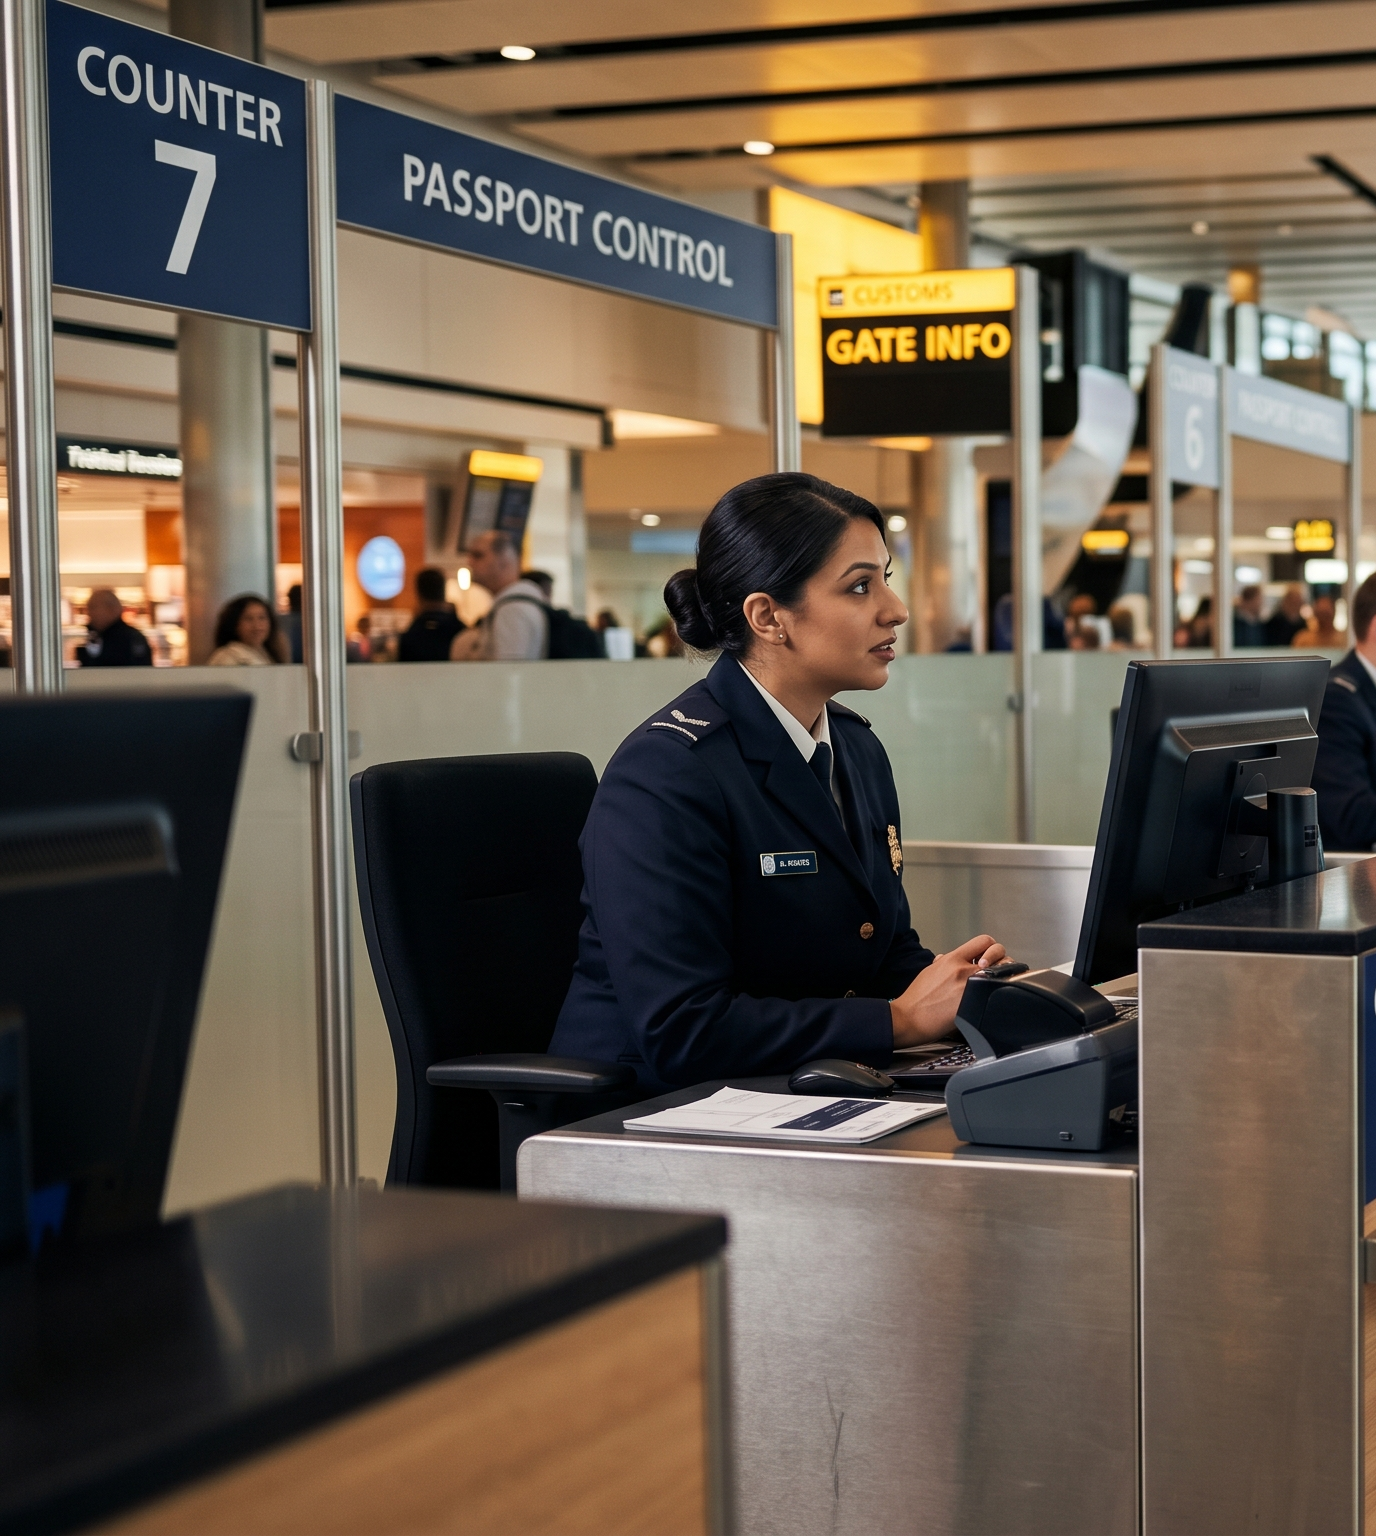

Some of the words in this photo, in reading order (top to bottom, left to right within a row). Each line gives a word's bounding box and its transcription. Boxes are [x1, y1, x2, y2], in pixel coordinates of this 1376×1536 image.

[77, 46, 284, 147] COUNTER
[154, 138, 217, 275] 7
[403, 153, 584, 246] PASSPORT
[592, 210, 734, 288] CONTROL
[852, 281, 953, 306] CUSTOMS
[826, 328, 918, 365] GATE
[924, 322, 1012, 359] INFO
[1184, 404, 1205, 472] 6
